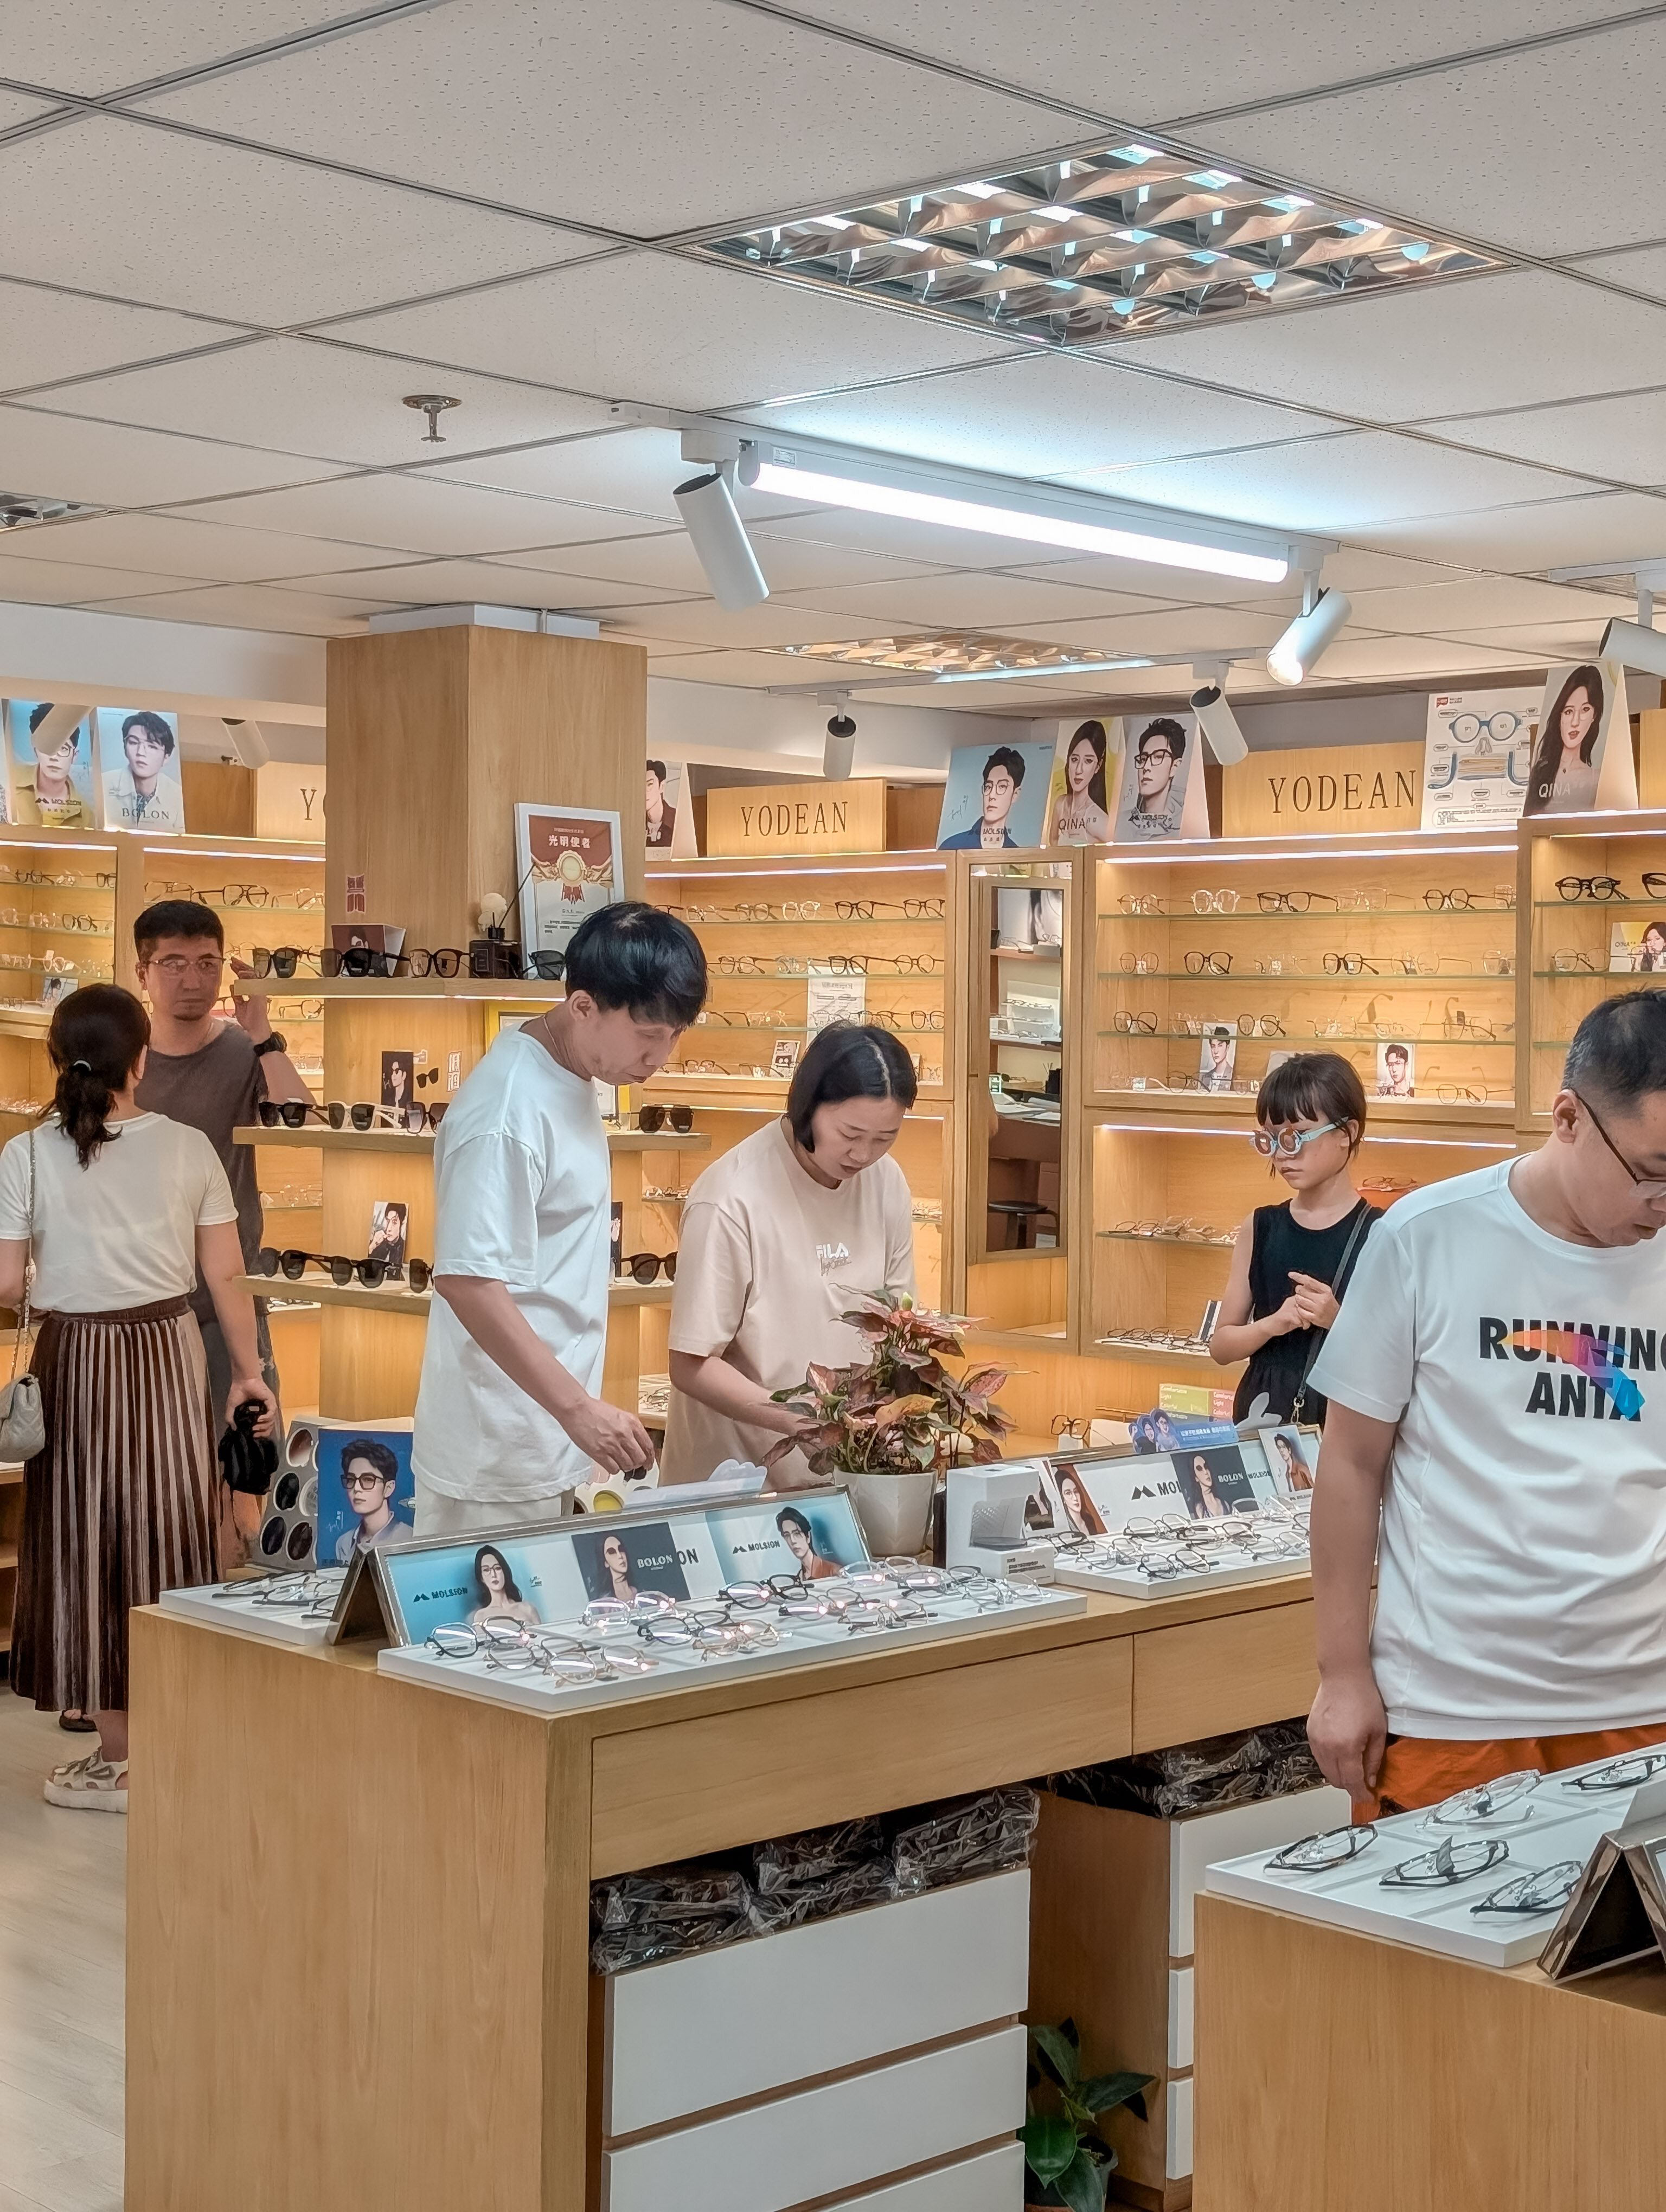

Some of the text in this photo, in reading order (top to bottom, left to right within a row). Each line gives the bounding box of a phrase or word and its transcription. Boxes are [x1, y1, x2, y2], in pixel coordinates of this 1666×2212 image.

[1268, 770, 1416, 813] YODEAN
[1539, 783, 1571, 798] QINA
[300, 788, 325, 820] Y
[122, 808, 170, 820] BOLON
[741, 801, 848, 837] YODEAN
[1058, 818, 1086, 831] QINA
[815, 1242, 849, 1259] FILA
[1479, 1317, 1666, 1372] RUNNIN
[1525, 1371, 1642, 1422] ANTA
[1218, 1472, 1244, 1483] BOLON
[748, 1540, 780, 1551] MOLSION
[637, 1554, 673, 1568] BOLON
